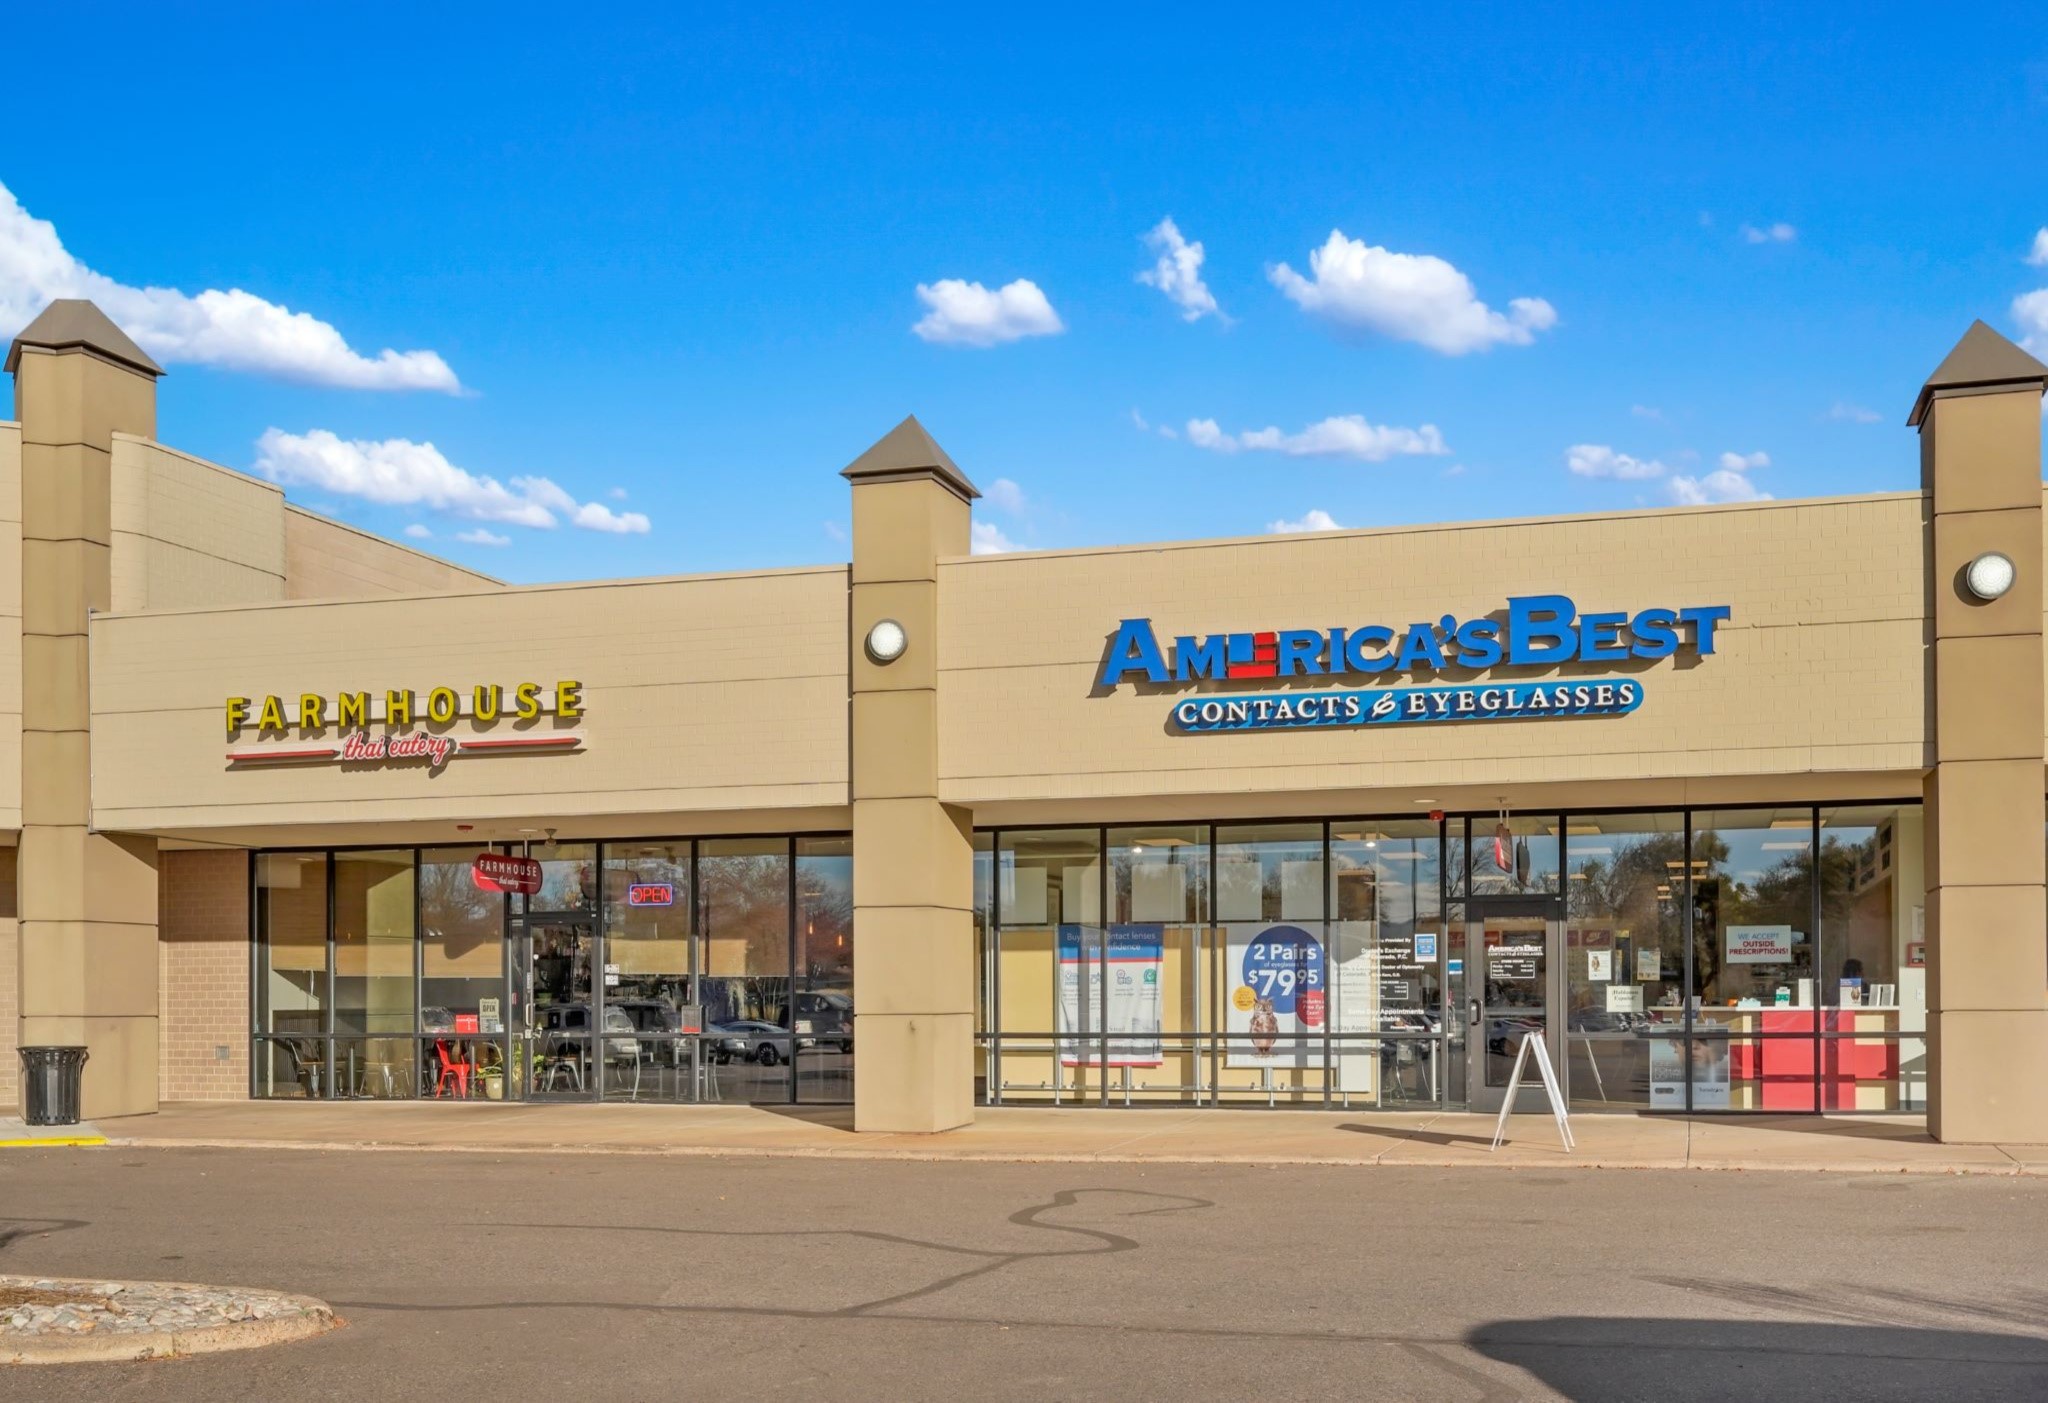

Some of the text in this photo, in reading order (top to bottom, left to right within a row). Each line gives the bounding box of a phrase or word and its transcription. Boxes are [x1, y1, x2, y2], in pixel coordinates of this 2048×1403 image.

[1506, 595, 1731, 665] BEST
[226, 681, 579, 731] FARMHOUSE
[1177, 695, 1361, 723] CONTACTS
[1408, 682, 1635, 714] EYEGLASSES
[344, 731, 450, 765] thai eatery
[479, 859, 537, 877] FARMHOUSE
[632, 886, 671, 904] OPEN
[1066, 932, 1080, 943] Buy
[1106, 931, 1130, 941] ontact
[1131, 930, 1155, 940] lenses
[1253, 943, 1317, 960] 2 Pairs
[1728, 947, 1789, 955] PRESCRIPTIONS!
[1380, 1009, 1425, 1017] Appointments
